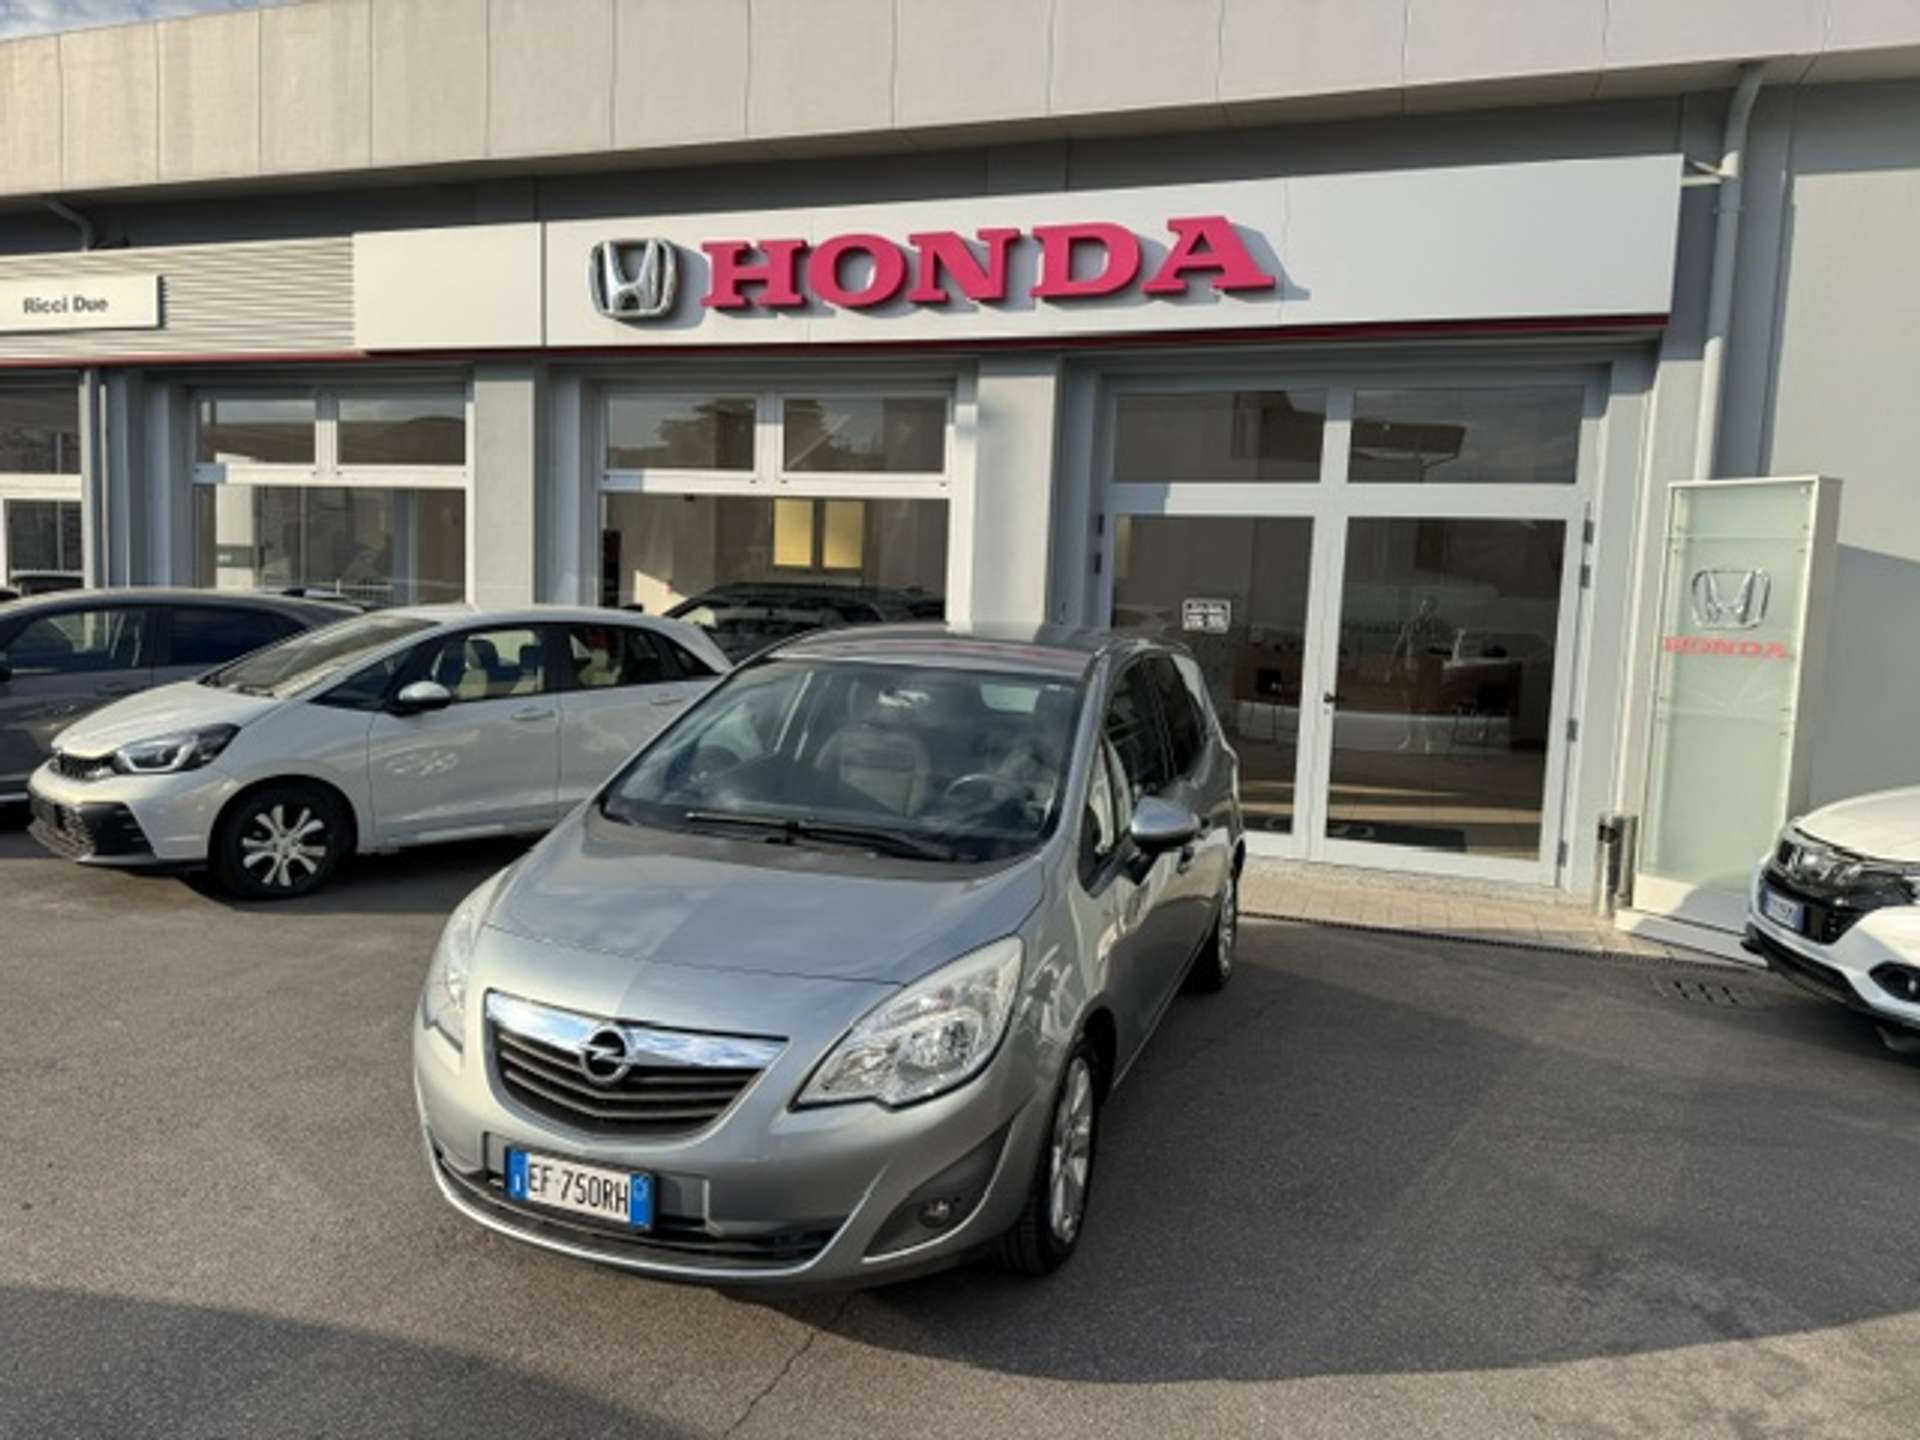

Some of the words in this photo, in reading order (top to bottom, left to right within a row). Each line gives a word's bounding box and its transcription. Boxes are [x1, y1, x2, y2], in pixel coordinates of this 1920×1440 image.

[702, 215, 1275, 309] HONDA
[23, 296, 68, 313] Ricci
[72, 295, 109, 313] Due
[1662, 634, 1794, 661] HONDA
[528, 1163, 552, 1193] EF
[560, 1169, 629, 1214] 750RH
